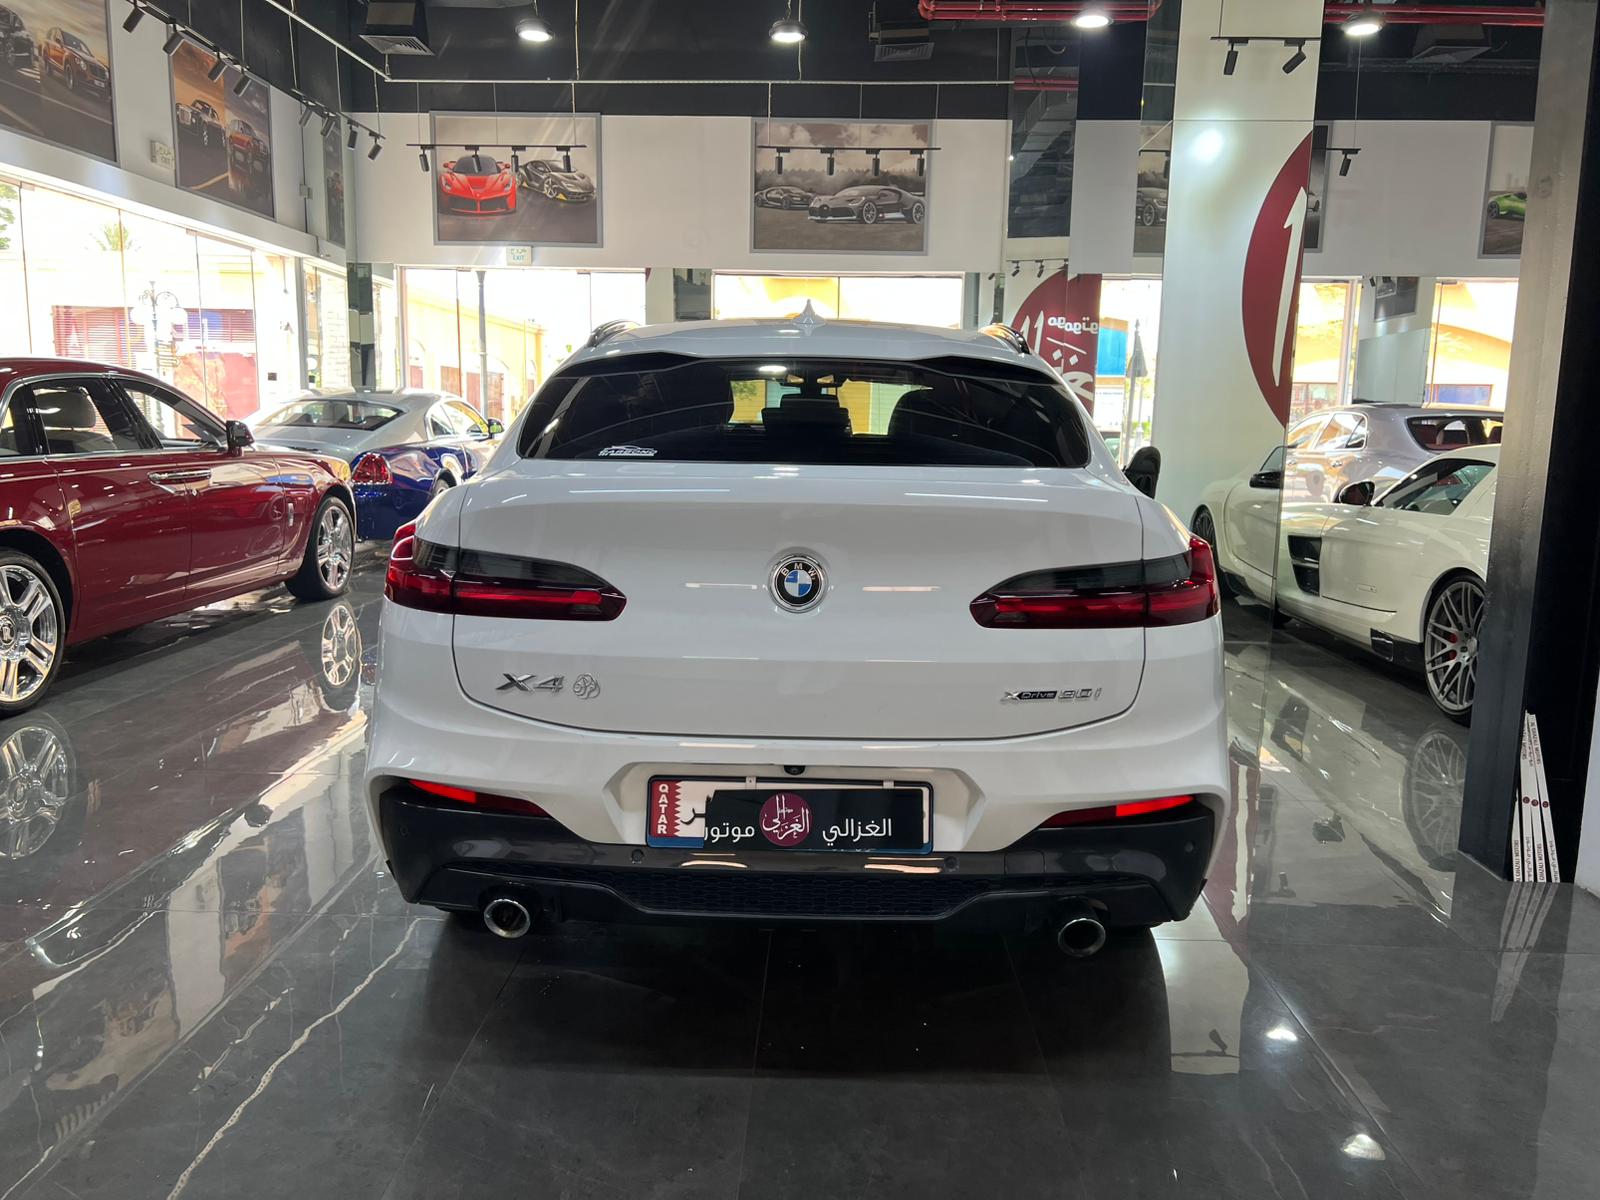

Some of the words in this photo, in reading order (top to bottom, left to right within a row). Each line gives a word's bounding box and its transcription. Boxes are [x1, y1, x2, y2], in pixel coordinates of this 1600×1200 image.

[780, 562, 817, 577] BMW
[495, 673, 565, 693] X4
[657, 783, 670, 834] QATAR
[822, 818, 892, 846] الغزالي
